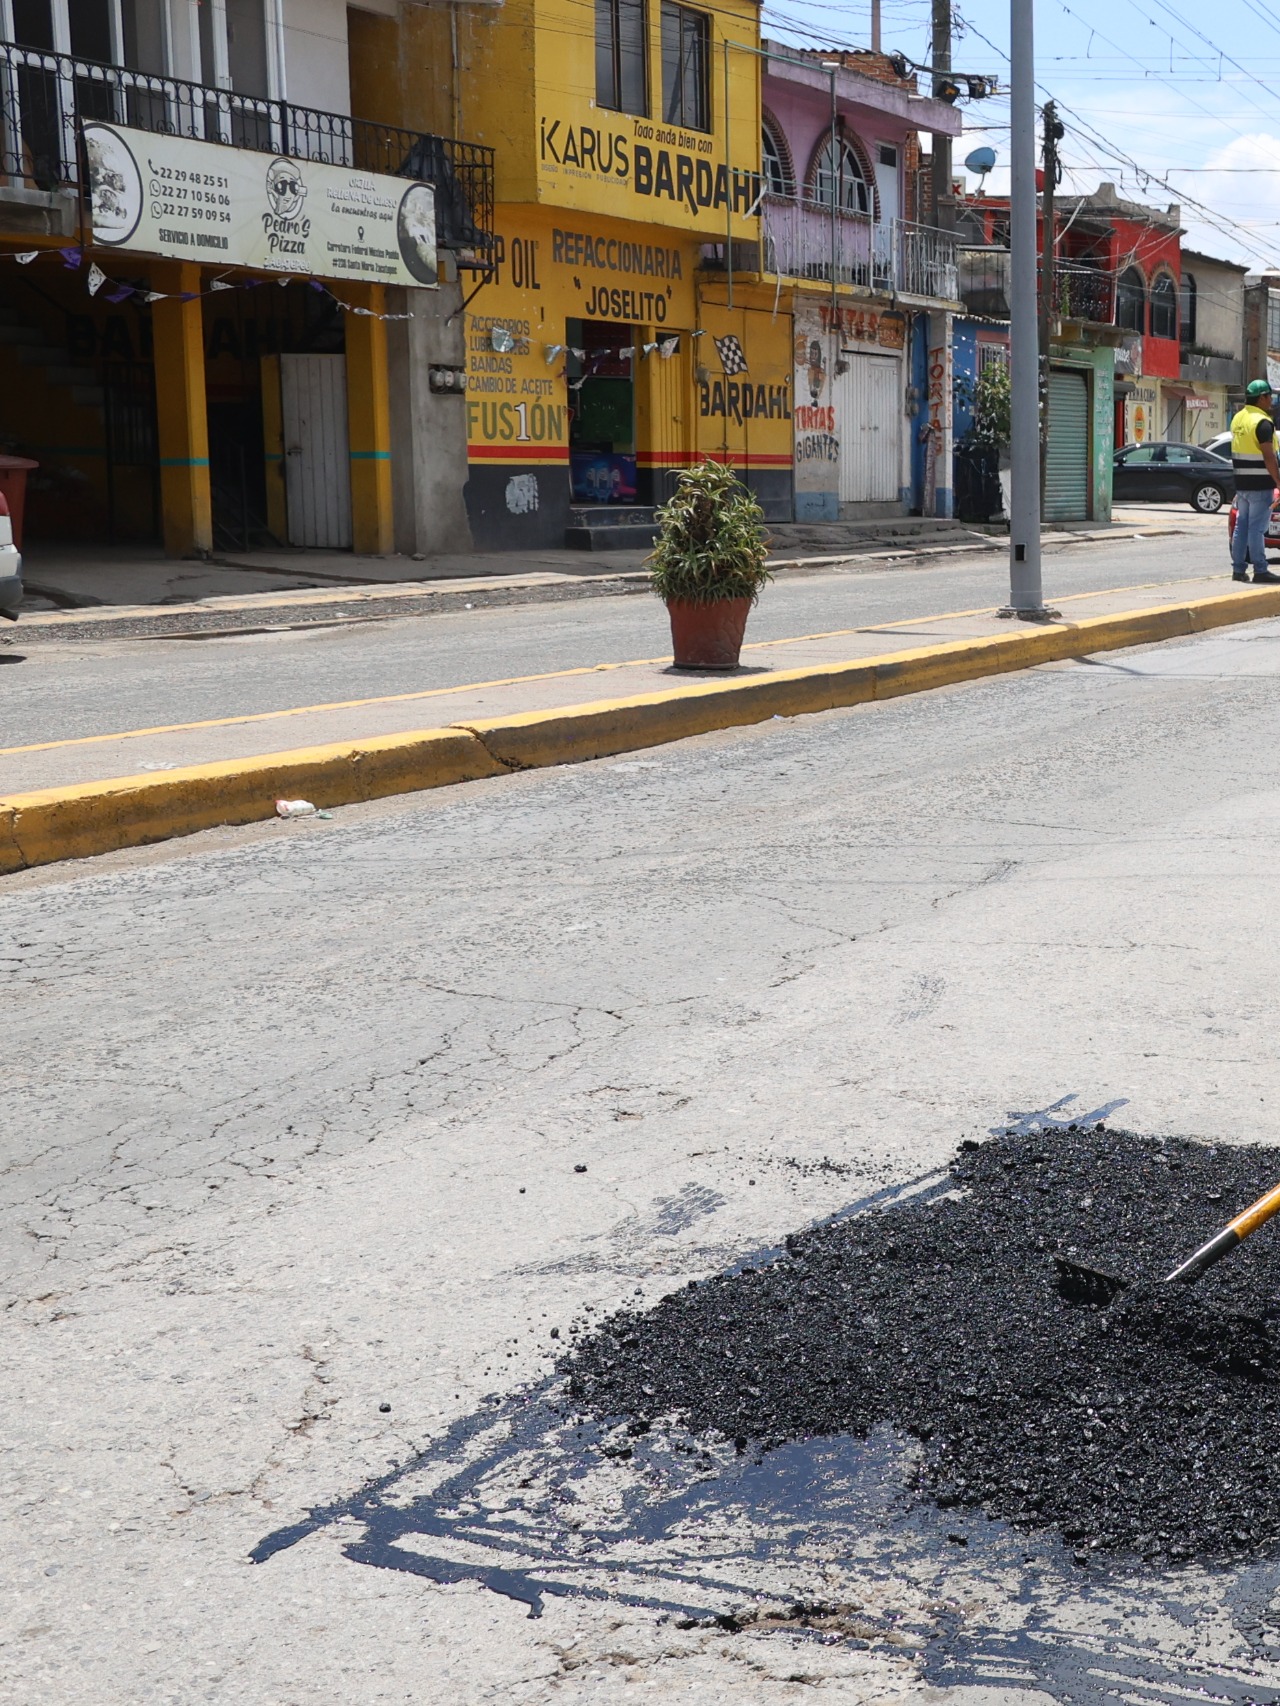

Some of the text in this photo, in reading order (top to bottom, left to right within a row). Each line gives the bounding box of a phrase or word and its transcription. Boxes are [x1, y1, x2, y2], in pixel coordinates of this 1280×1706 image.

[633, 119, 713, 155] Todo anda bien con
[160, 167, 228, 188] 22 29 48 25 51
[634, 144, 762, 217] BARDAHL
[162, 185, 230, 206] 22 27 10 56 06
[163, 203, 231, 223] 22 27 59 09 54
[341, 206, 377, 220] encuentras
[159, 228, 228, 250] SERVICIO A DOMICILIO
[268, 232, 305, 254] Pizza
[552, 228, 683, 280] REFACCIONARIA
[470, 316, 530, 336] ACCESORIOS
[470, 356, 512, 374] BANDAS
[468, 375, 553, 395] CAMBIO DE ACEITE
[700, 380, 791, 427] BARDAHL
[795, 406, 835, 431] TORTAS
[796, 433, 840, 463] GIGANTES
